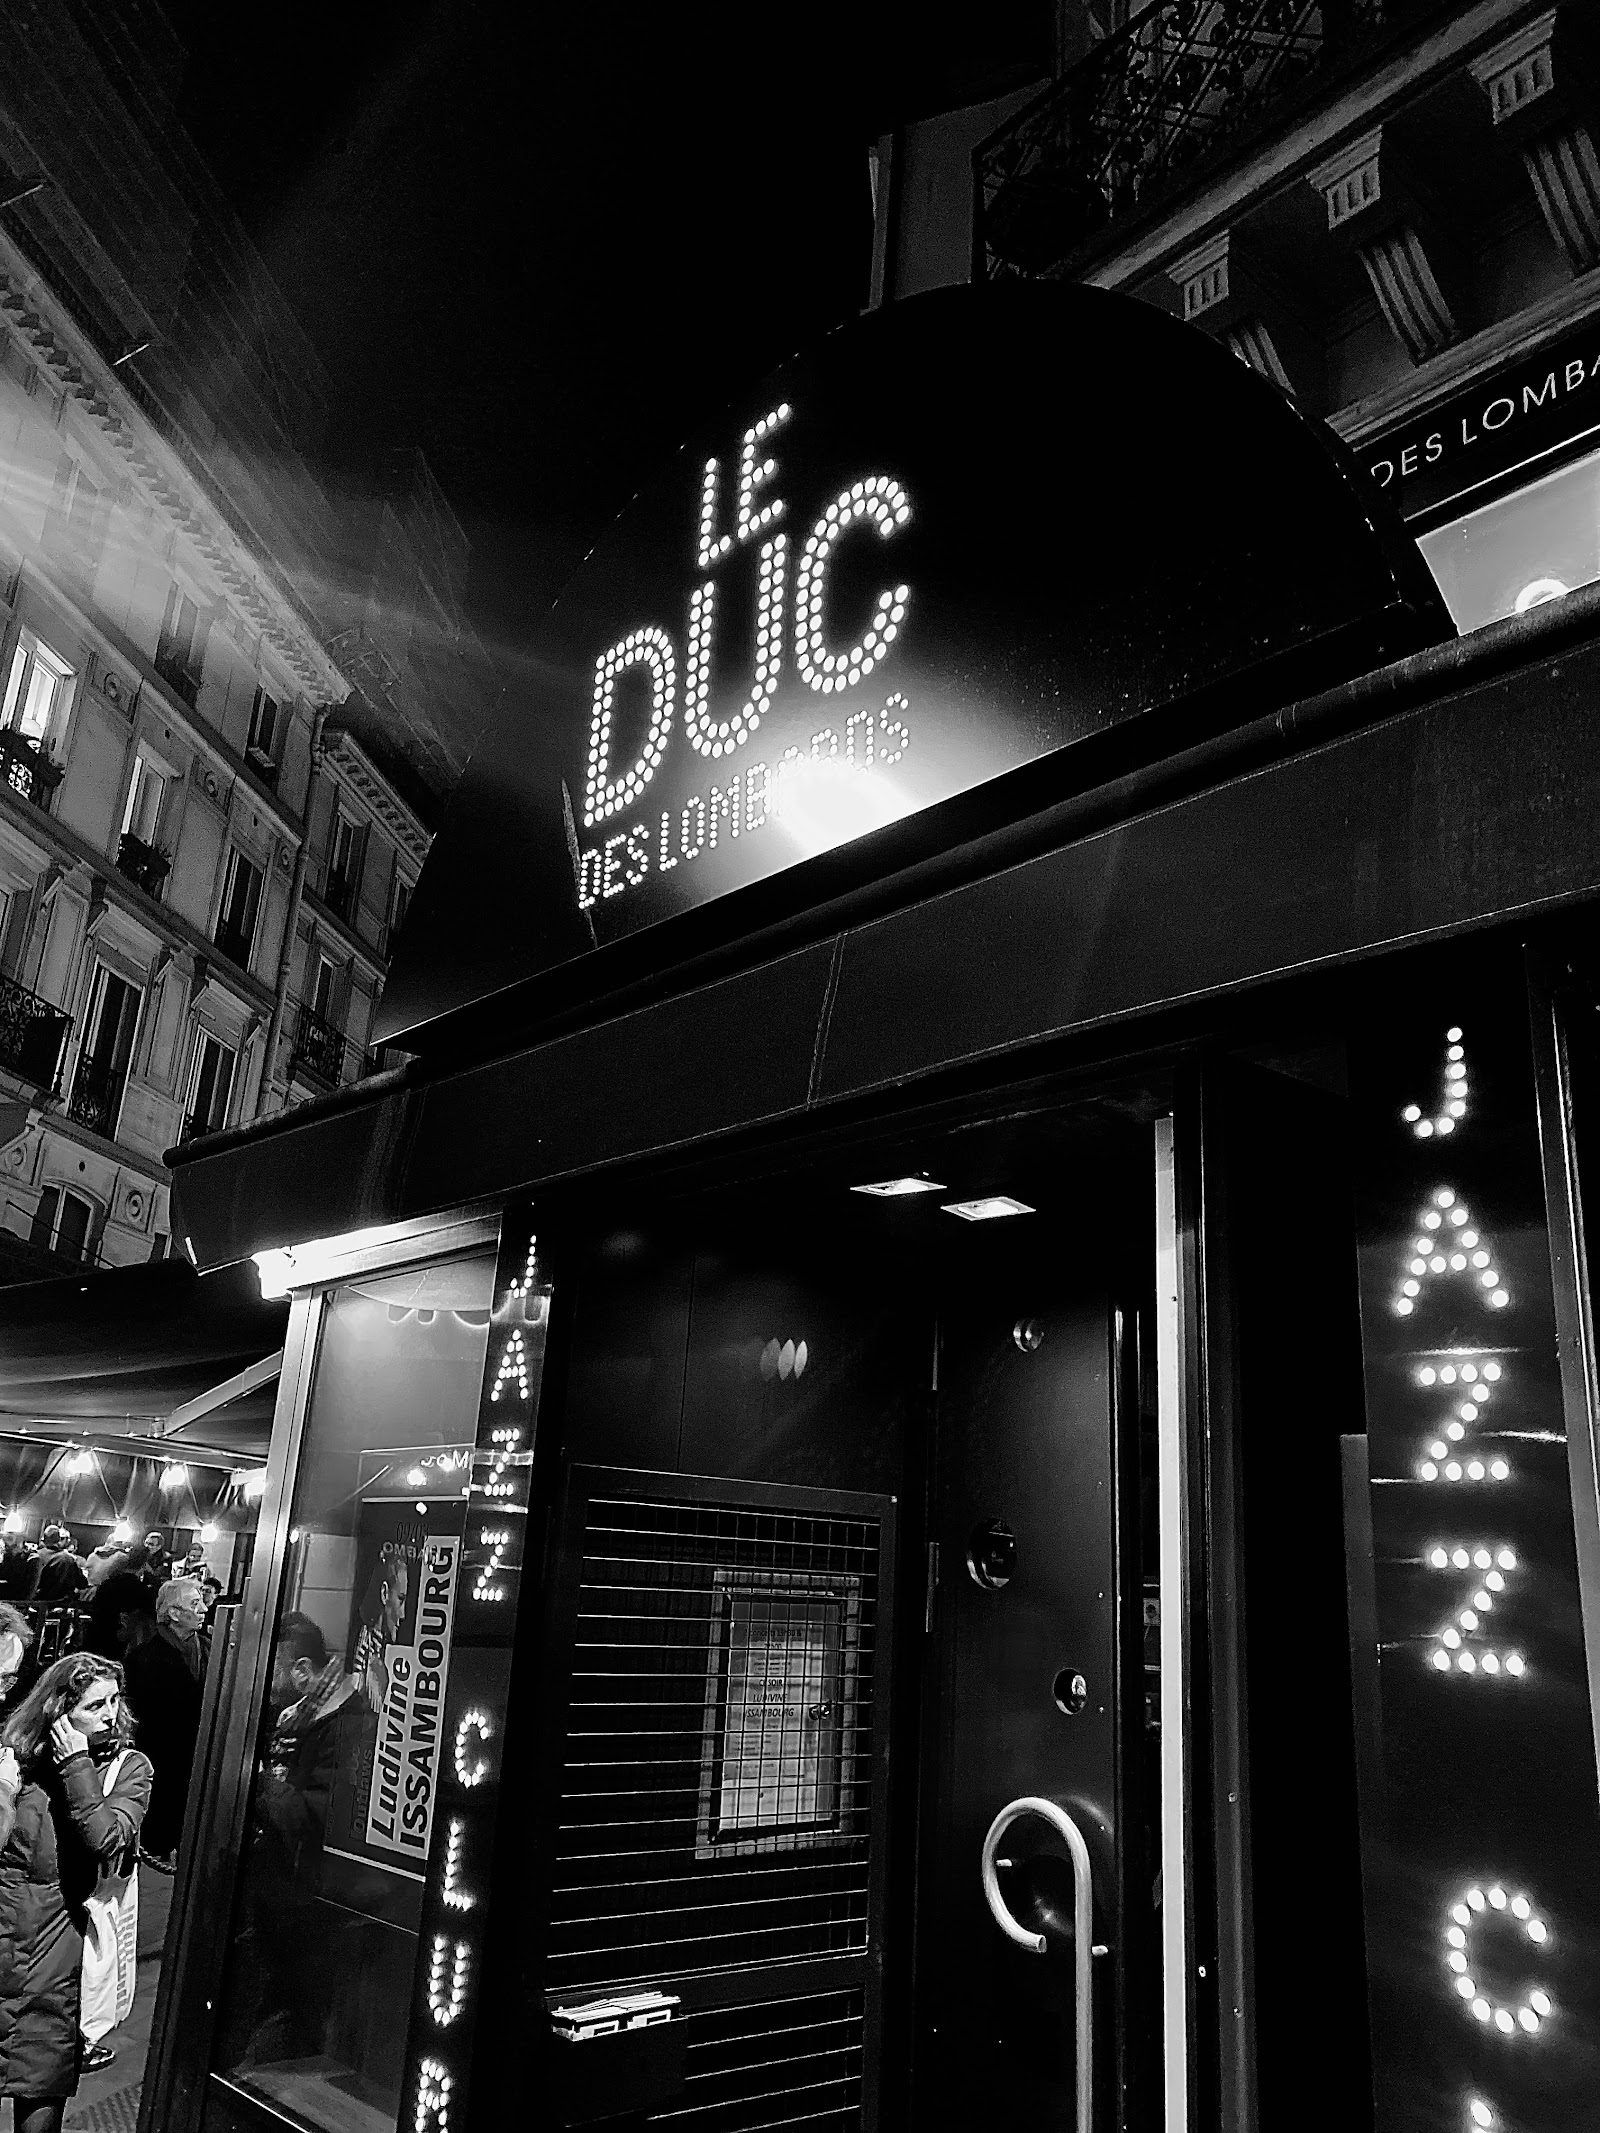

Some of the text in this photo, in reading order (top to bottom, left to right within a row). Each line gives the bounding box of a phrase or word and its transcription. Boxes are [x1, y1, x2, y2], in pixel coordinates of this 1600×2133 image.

[698, 403, 788, 566] LE
[1371, 433, 1443, 487] DES
[583, 476, 909, 827] DUC
[578, 824, 649, 909] DES
[473, 1234, 537, 1602] JAZZ
[1396, 1027, 1525, 1677] JAZZ
[371, 1657, 411, 1841] Ludivine
[400, 1548, 454, 1850] ISSAMBOURG
